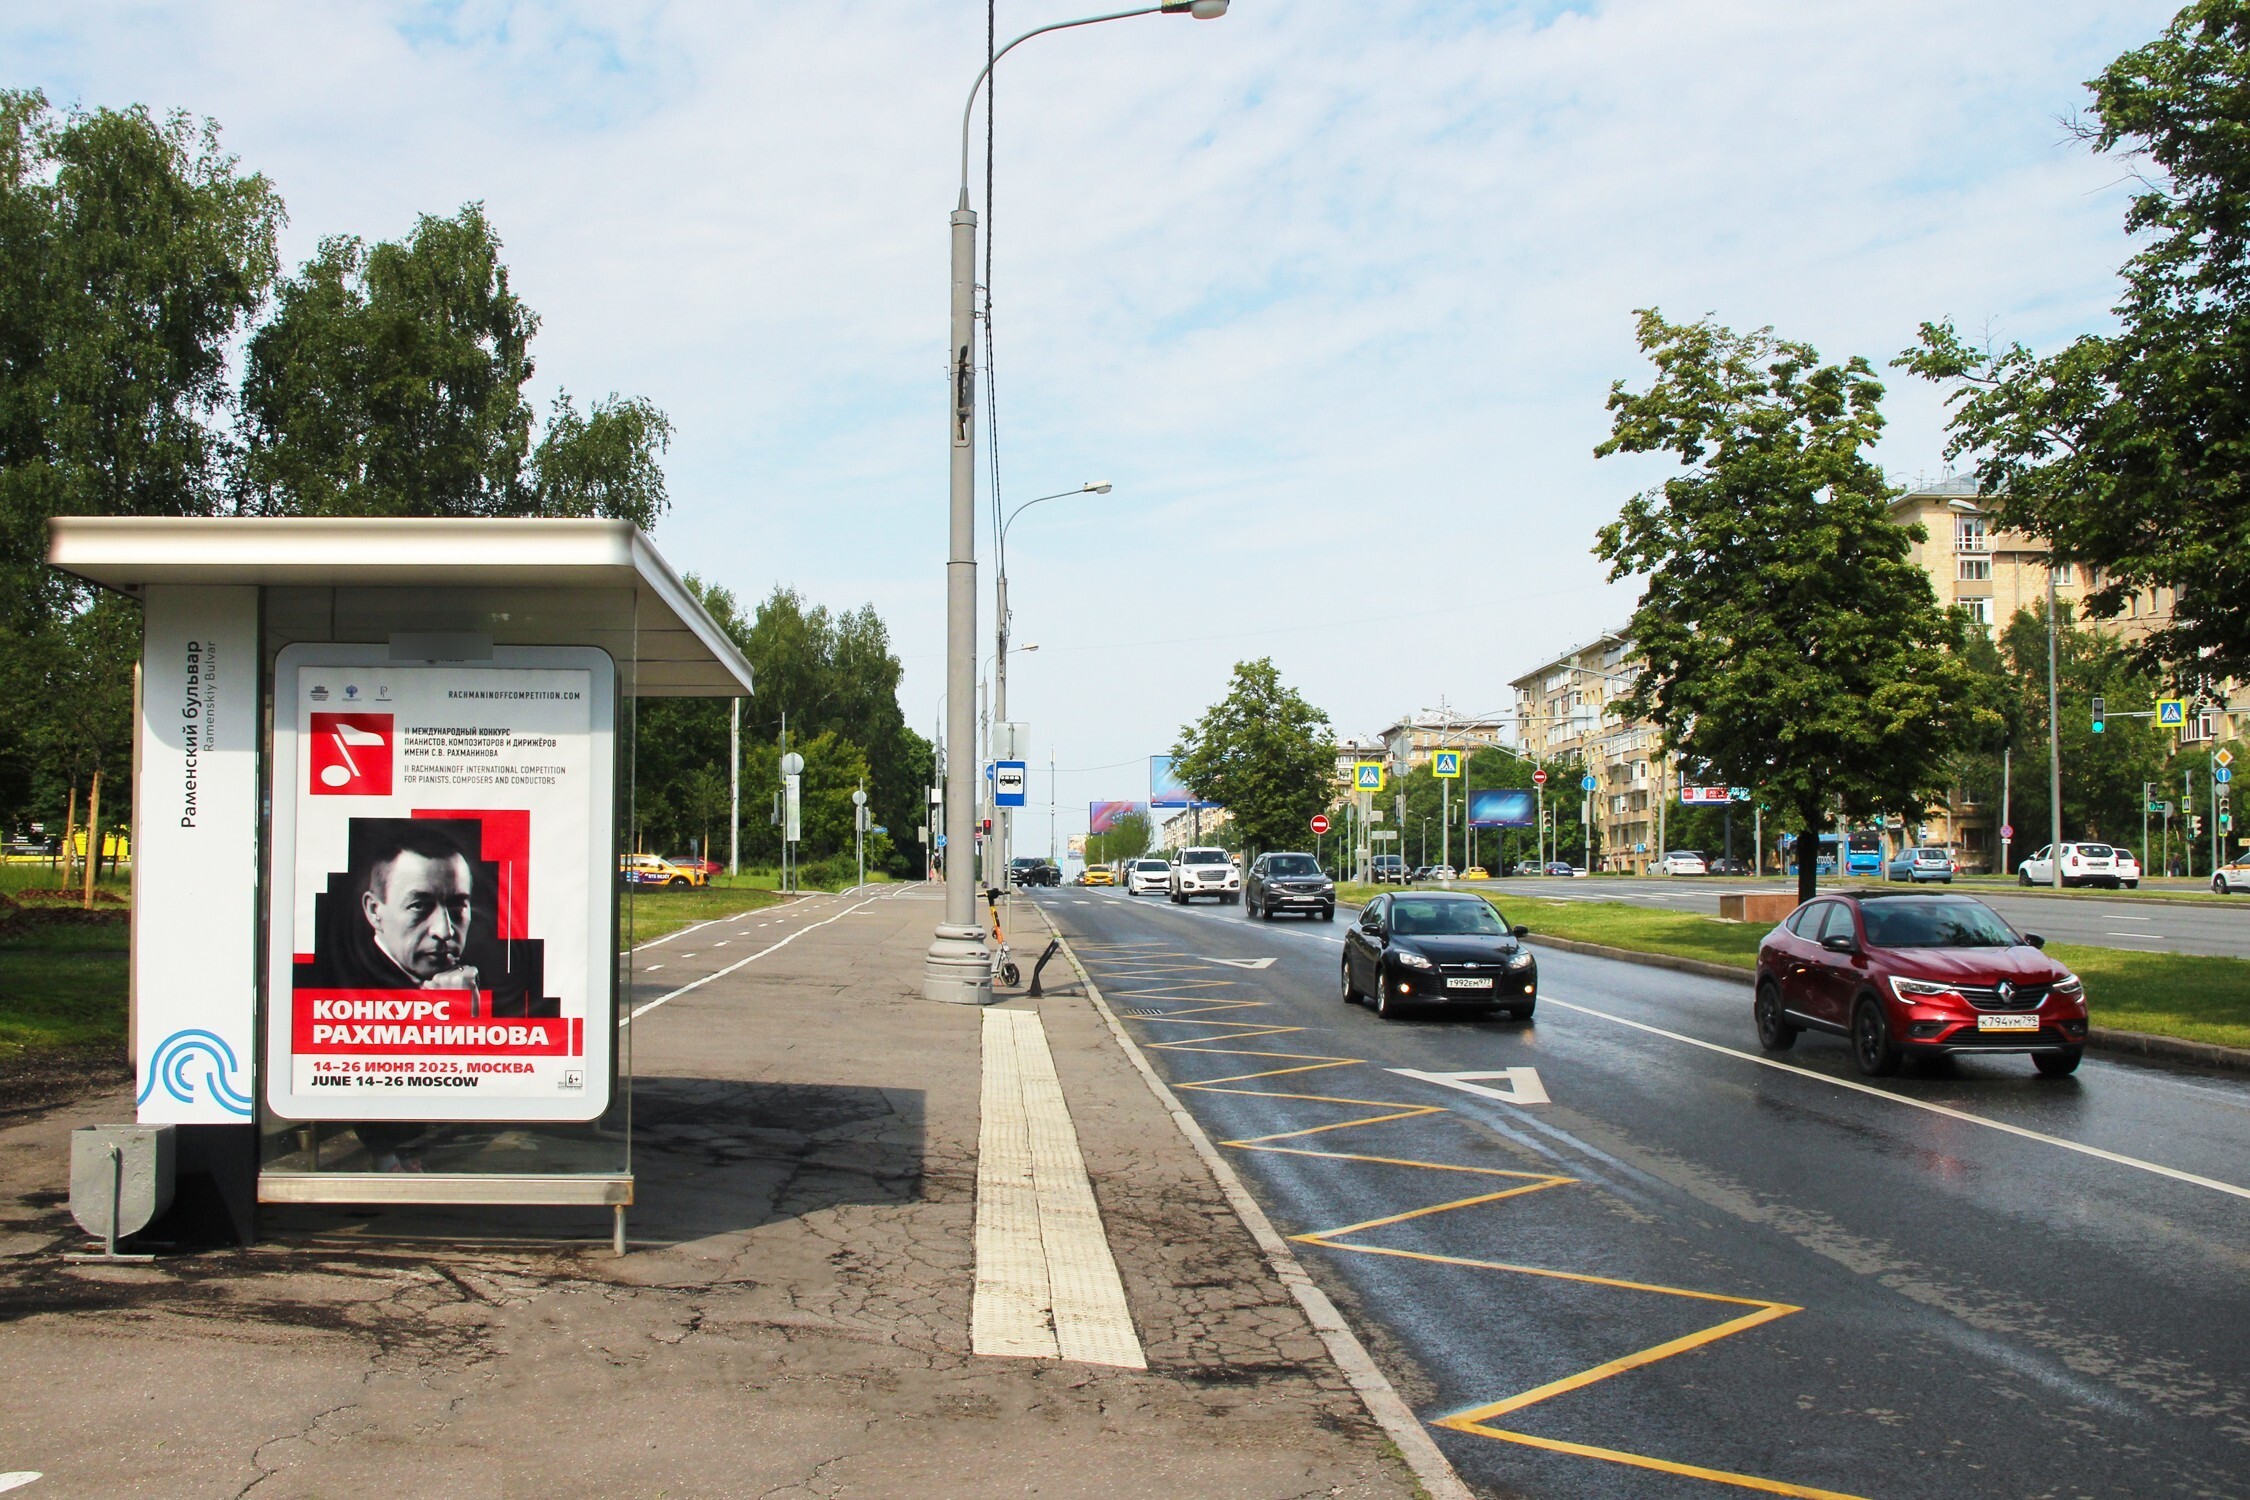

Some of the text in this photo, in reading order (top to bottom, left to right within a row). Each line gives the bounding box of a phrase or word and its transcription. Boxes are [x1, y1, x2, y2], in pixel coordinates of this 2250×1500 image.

[203, 641, 218, 752] Ramenskiy Bulvar
[448, 691, 581, 700] RACHMANINOFFCOMPETITION.COM
[181, 641, 203, 828] Раменский бульвар
[412, 727, 477, 736] МЕЖДУНАРОДНЫЙ
[479, 728, 511, 736] КОНКУРС
[404, 738, 448, 747] ПИАНИСТОВ,
[449, 739, 504, 747] КОМПОЗИТОРОВ
[513, 738, 557, 748] ДИРИЖЁРОВ
[404, 749, 498, 757] ИМЕНИ С.В. РАХМАНИНОВА
[411, 765, 464, 773] RACHMANINOFF
[466, 766, 518, 774] INTERNATIONAL
[520, 766, 566, 774] COMPETITION
[419, 776, 451, 784] PIANISTS,
[452, 776, 493, 784] COMPOSERS
[511, 777, 556, 785] CONDUCTORS
[313, 1000, 450, 1021] КОНКУРС
[313, 1025, 549, 1046] РАХМАНИНОВА
[364, 1062, 415, 1073] ИЮНЯ
[419, 1062, 463, 1075] 2025,
[466, 1063, 535, 1074] МОСКВА
[311, 1076, 351, 1087] JUNE
[407, 1077, 479, 1087] MOSCOW
[568, 1075, 579, 1084] 6+
